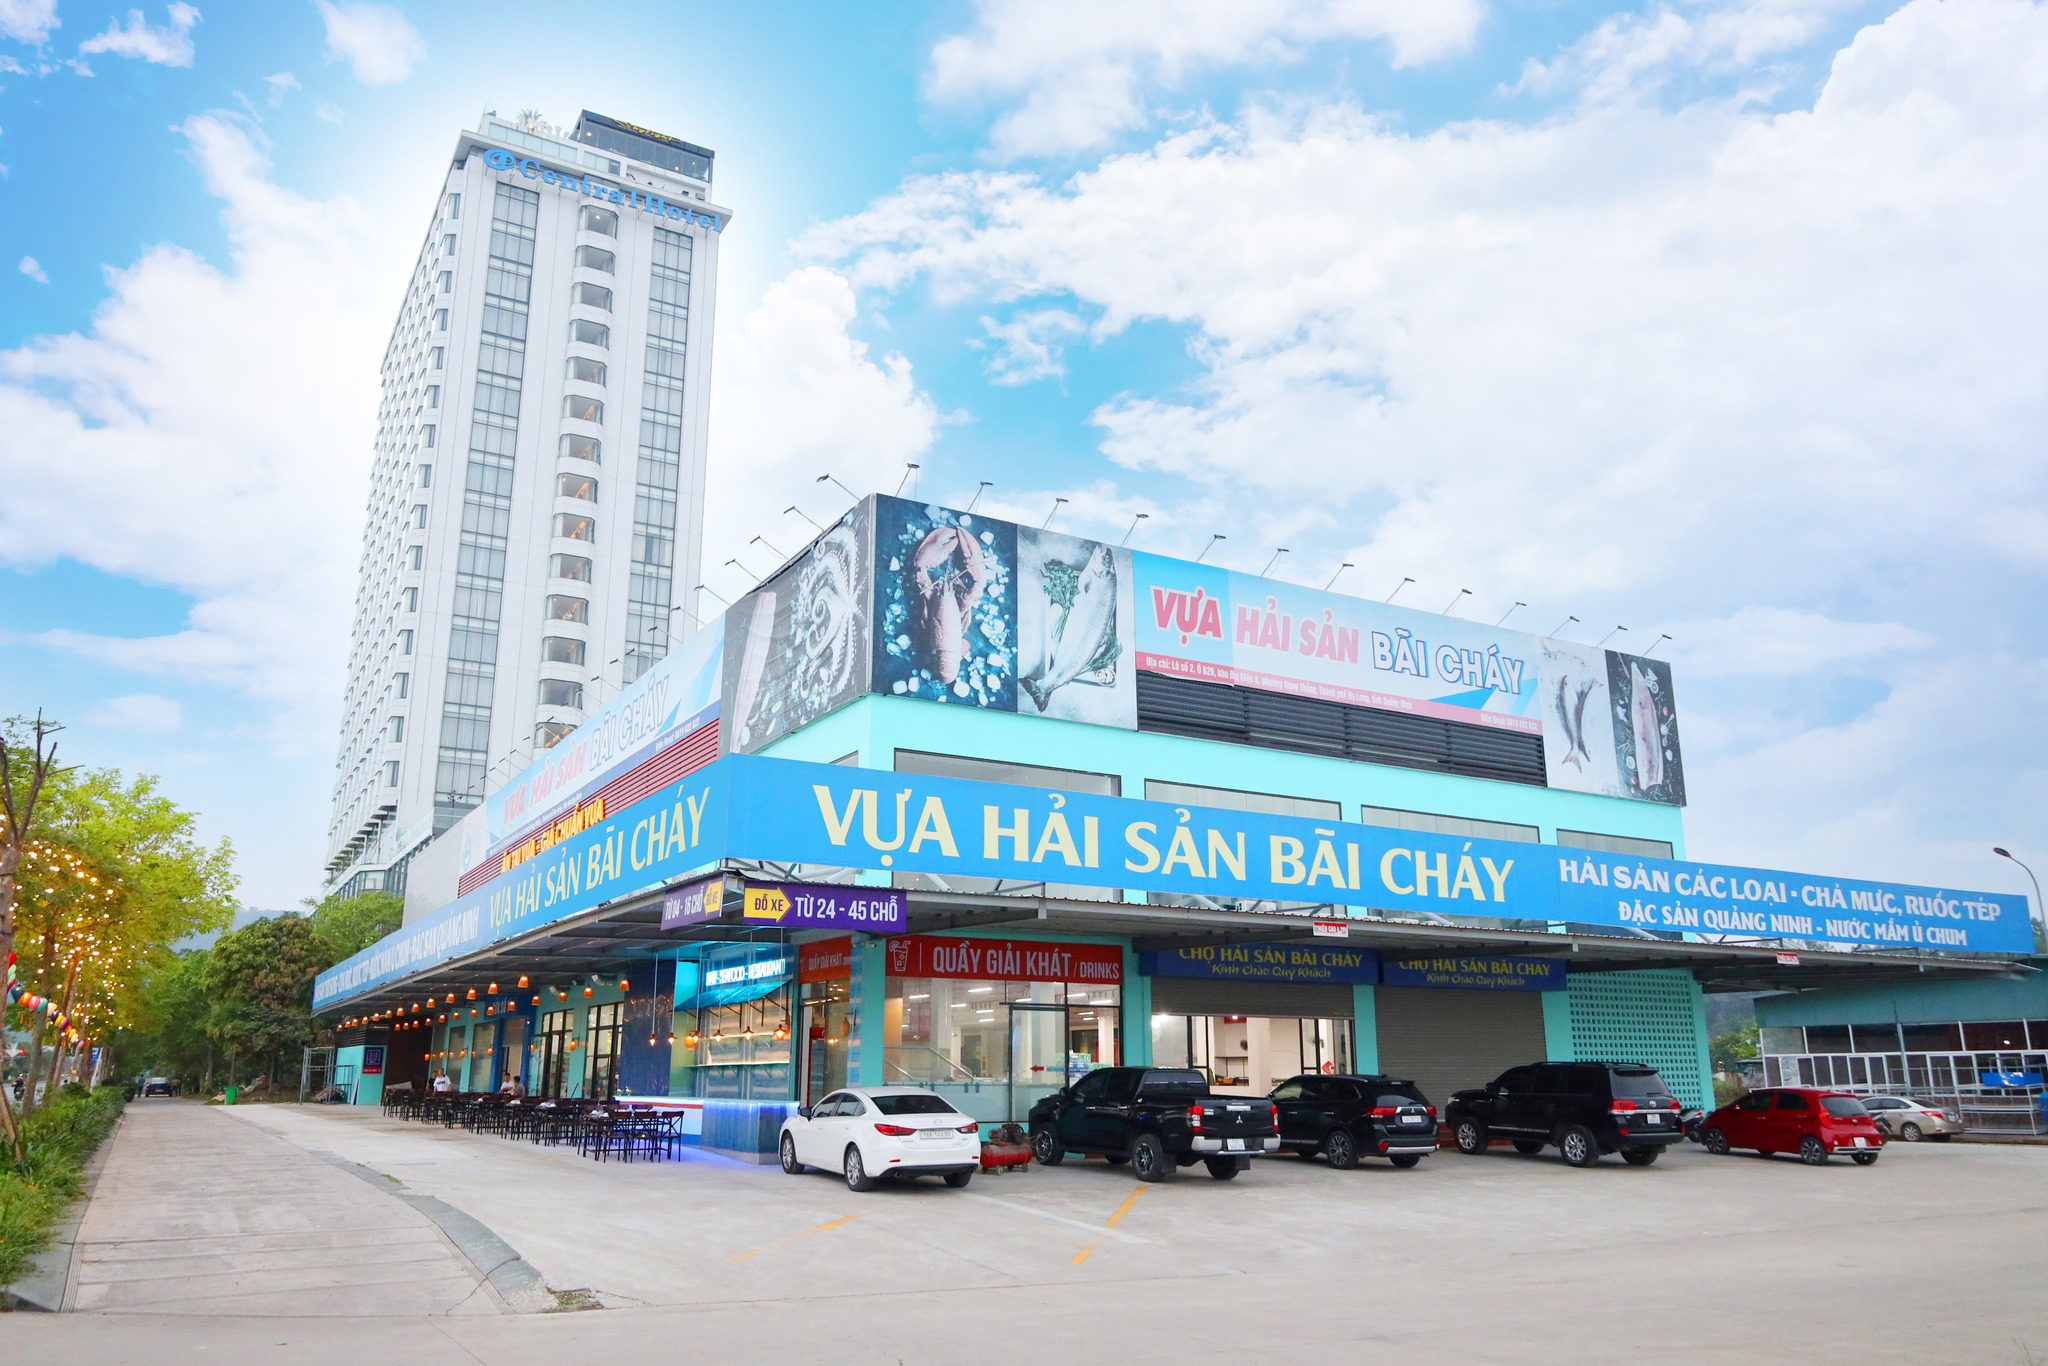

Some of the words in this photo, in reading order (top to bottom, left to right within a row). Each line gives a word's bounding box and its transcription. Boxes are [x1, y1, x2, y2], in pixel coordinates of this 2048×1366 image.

[519, 159, 638, 209] Central
[643, 193, 720, 233] Hotel
[1151, 587, 1223, 646] VỰA
[1235, 598, 1291, 652] HẢI
[1299, 609, 1360, 665] SẢN
[1371, 627, 1429, 678] BÃI
[1435, 644, 1524, 695] CHÁY
[529, 758, 555, 808] HẢI
[555, 735, 589, 791] SẢN
[590, 710, 616, 772] BÃI
[618, 671, 670, 751] CHÁY
[489, 884, 512, 935] VỰA
[515, 863, 541, 919] HẢI
[544, 846, 582, 907] SẢN
[585, 825, 624, 891] BÃI
[630, 784, 710, 871] CHÁY
[812, 784, 960, 866] VỰA
[983, 793, 1099, 868] HẢI
[1124, 807, 1246, 881] SẢN
[1269, 828, 1361, 890] BÃI
[1380, 842, 1515, 902] CHÁY
[754, 894, 768, 910] ĐỖ
[771, 899, 783, 911] XE
[795, 894, 814, 918] TỪ
[816, 898, 836, 918] 24
[848, 900, 866, 920] 45
[870, 895, 898, 922] CHỖ
[1559, 856, 1608, 887] HẢI
[1613, 862, 1670, 893] SẢN
[1674, 868, 1727, 899] CÁC
[1730, 878, 1788, 906] LOẠI
[1801, 883, 1848, 910] CHẢ
[1850, 889, 1902, 917] MỰC,
[1904, 891, 1962, 918] RUỐC
[1963, 896, 2001, 922] TÉP
[1618, 899, 1657, 927] ĐẶC
[1661, 900, 1699, 927] SẢN
[1703, 906, 1766, 932] QUẢNG
[1771, 914, 1813, 935] NINH
[1825, 918, 1870, 939] NƯỚC
[1874, 917, 1910, 941] MẮM
[1912, 920, 1923, 942] Ủ
[1926, 927, 1967, 946] CHUM
[932, 940, 981, 974] QUẦY
[986, 943, 1021, 975] GIẢI
[1026, 948, 1071, 977] KHÁT
[1080, 961, 1119, 979] DRINKS
[1221, 944, 1248, 962] HẢI
[1254, 945, 1286, 964] SẢN
[1291, 949, 1317, 965] BÃI
[1322, 950, 1363, 967] CHÁY
[1517, 960, 1550, 976] CHÁY
